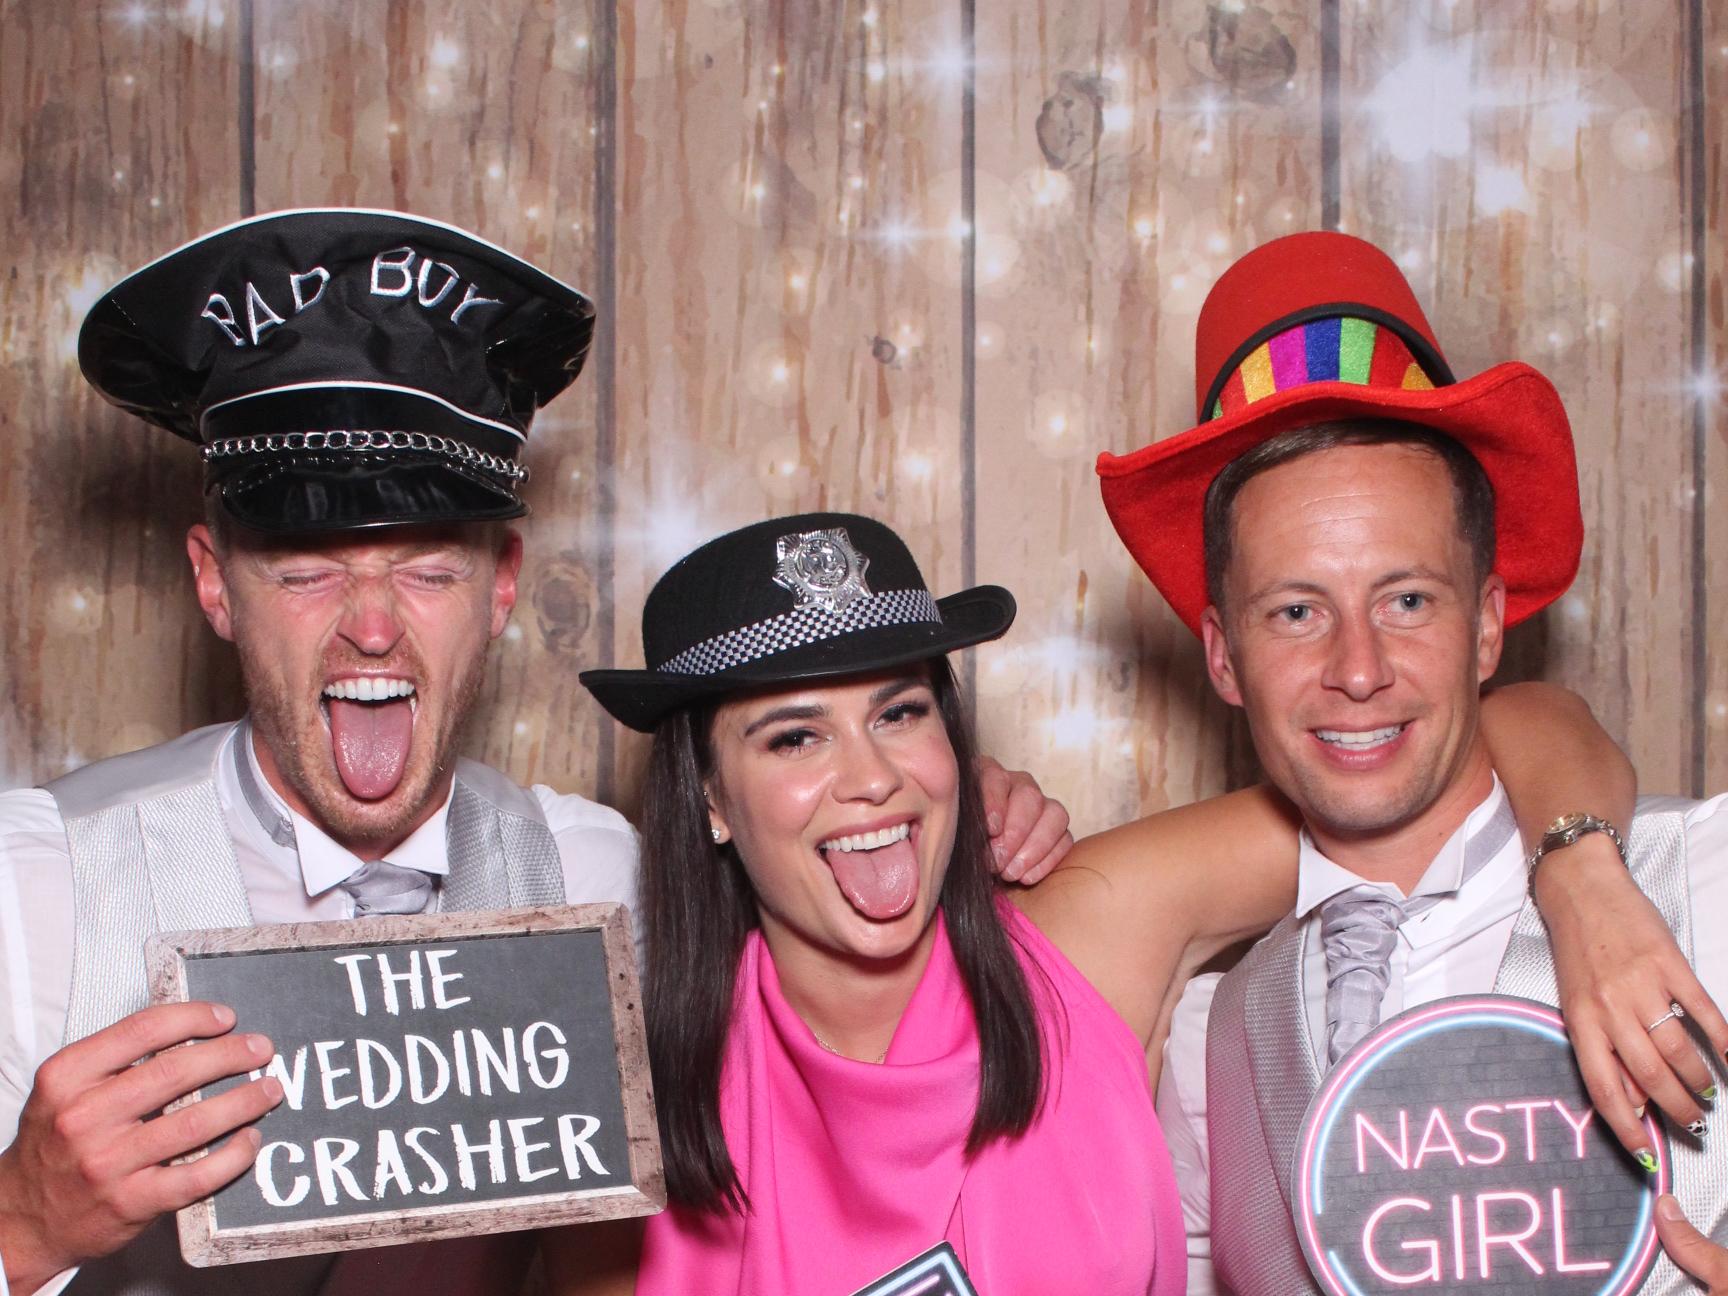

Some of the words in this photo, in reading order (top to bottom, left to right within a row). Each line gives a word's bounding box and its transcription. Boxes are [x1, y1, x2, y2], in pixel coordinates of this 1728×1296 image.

[370, 246, 504, 325] BOY
[333, 949, 471, 1017] THE
[253, 1113, 612, 1207] CRASHER
[1354, 1099, 1594, 1174] NASTY
[1361, 1187, 1612, 1285] GIRL
